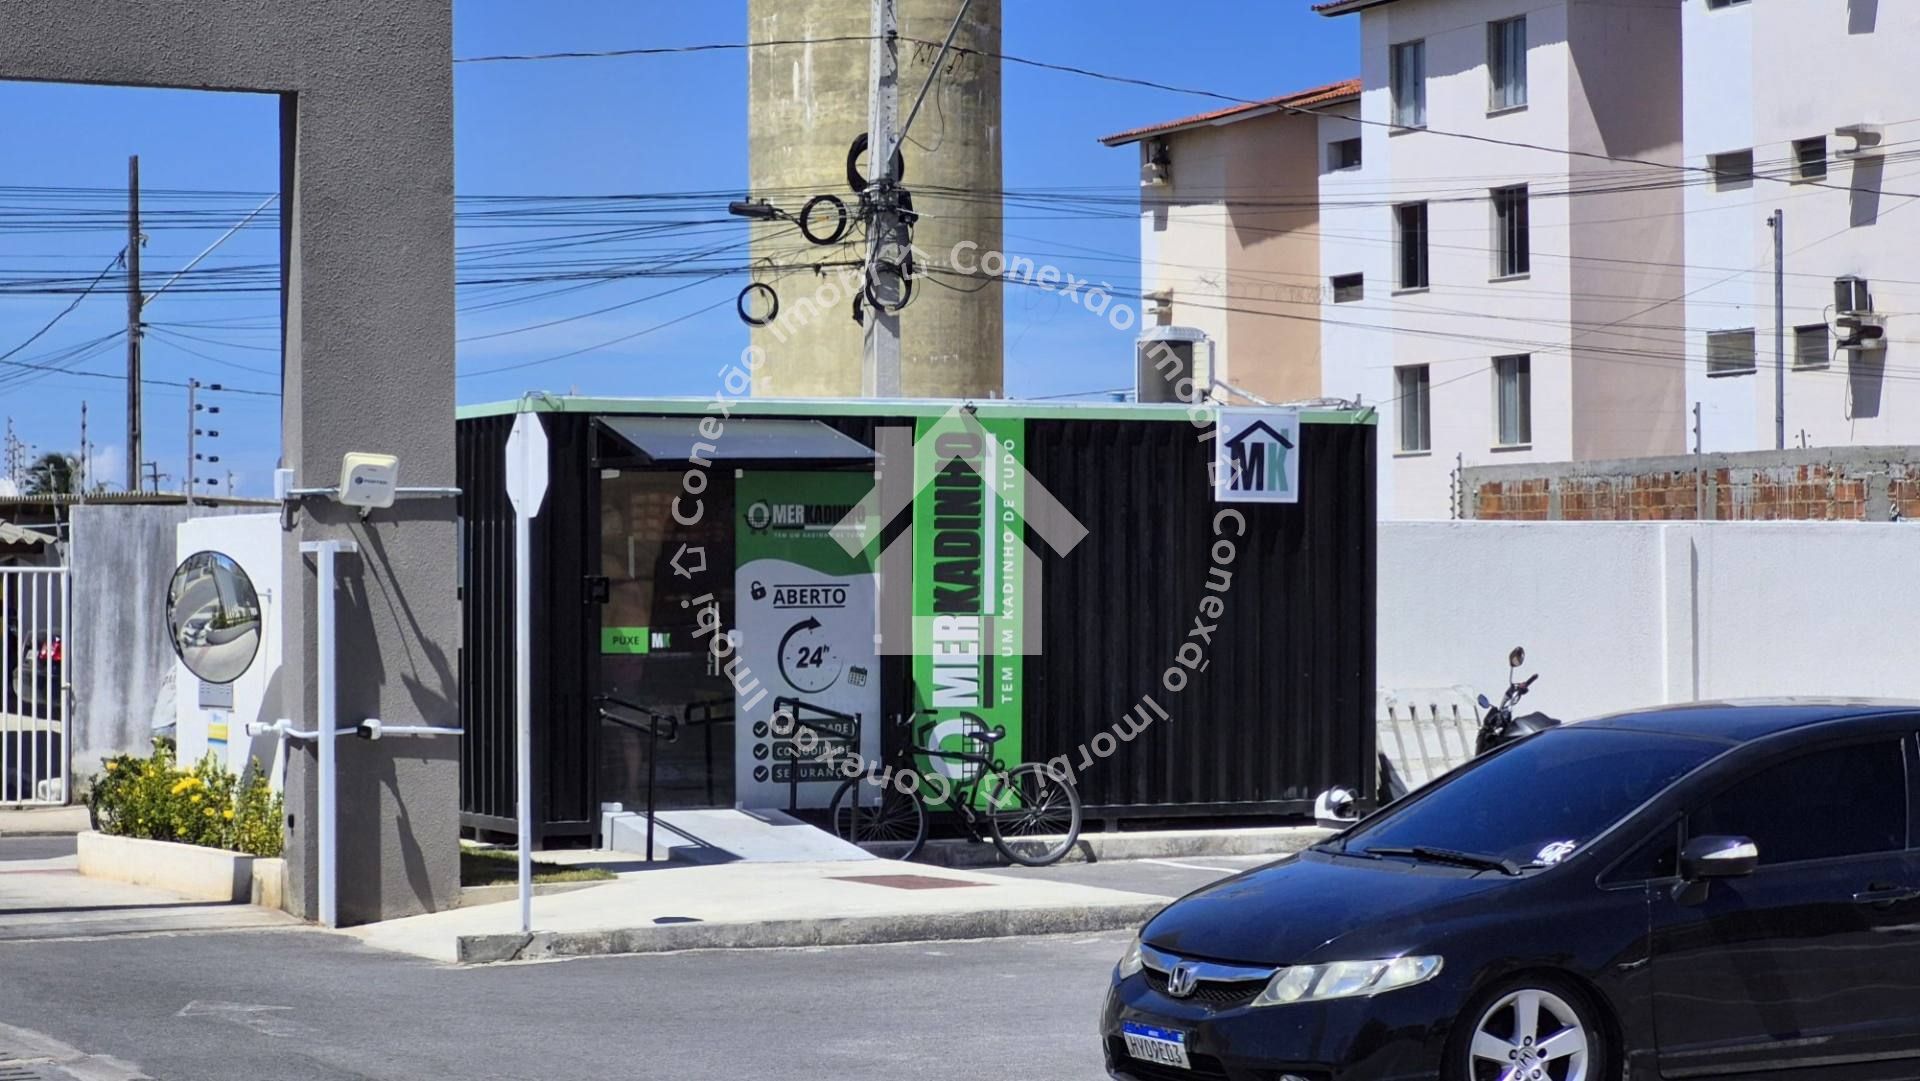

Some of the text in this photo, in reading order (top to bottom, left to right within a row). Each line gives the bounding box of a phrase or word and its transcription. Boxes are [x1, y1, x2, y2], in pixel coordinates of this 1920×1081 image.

[1230, 429, 1289, 491] MK
[931, 432, 983, 708] MERKADINHO
[1001, 438, 1016, 704] TEM UM KADINHO DE TUDO
[773, 588, 847, 605] ABERTO
[612, 635, 640, 646] PUXE
[776, 767, 850, 779] SEURANÇ
